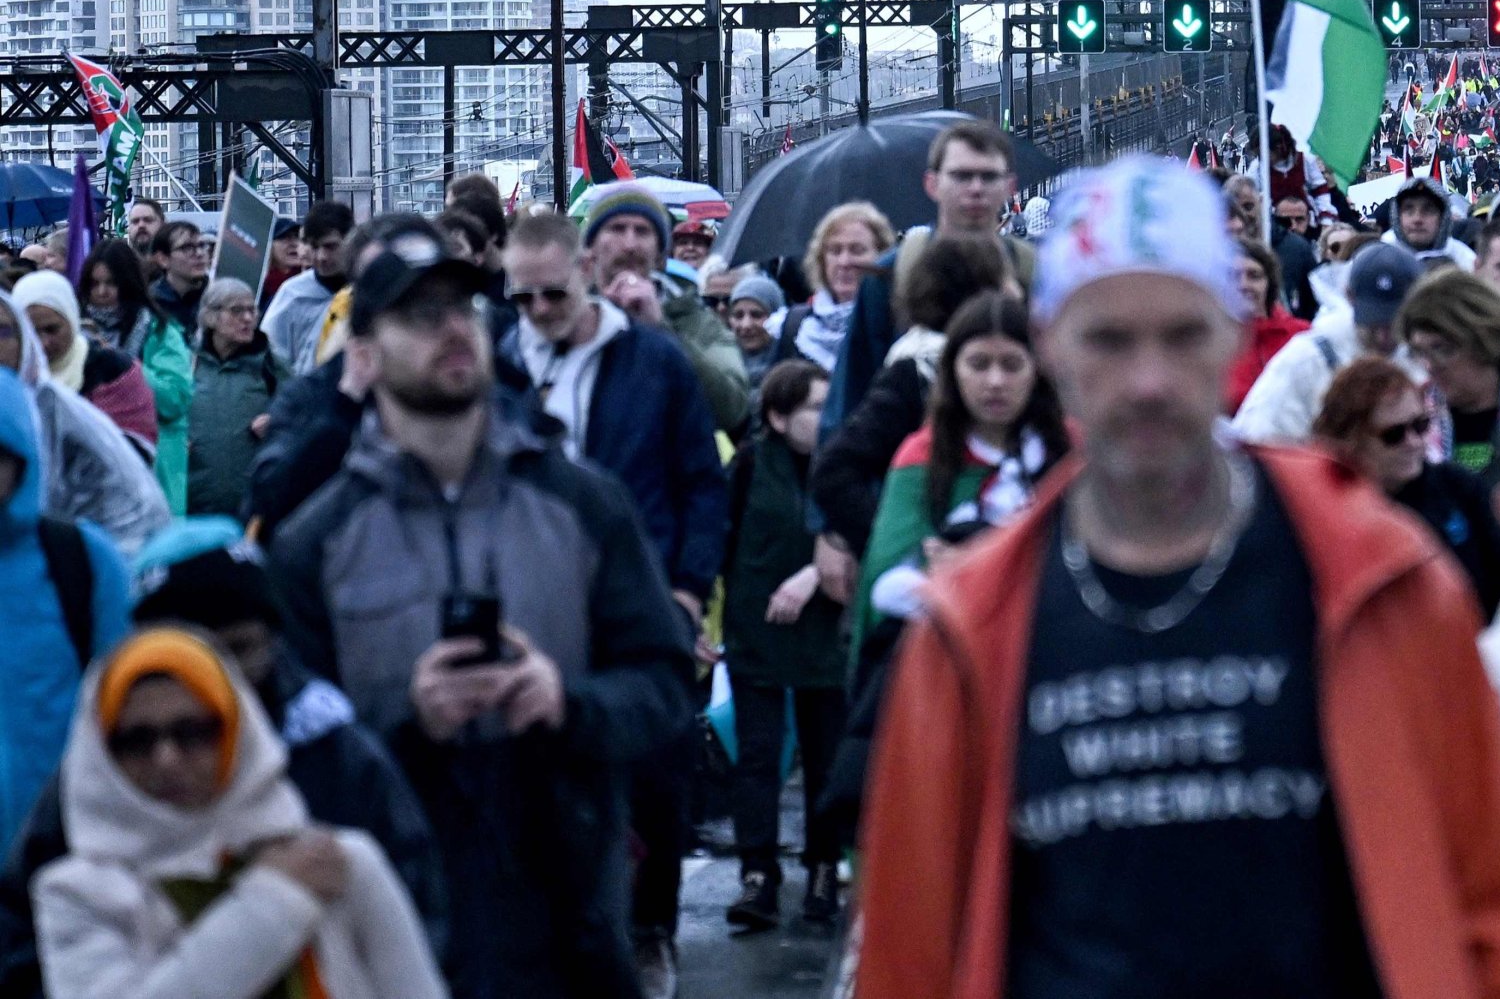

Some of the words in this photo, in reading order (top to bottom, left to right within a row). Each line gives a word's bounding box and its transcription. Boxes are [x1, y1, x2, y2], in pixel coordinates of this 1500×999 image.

[1182, 39, 1193, 51] 2
[1391, 35, 1403, 48] 4
[1027, 654, 1290, 736] DESTROY
[1061, 709, 1244, 779] WHITE
